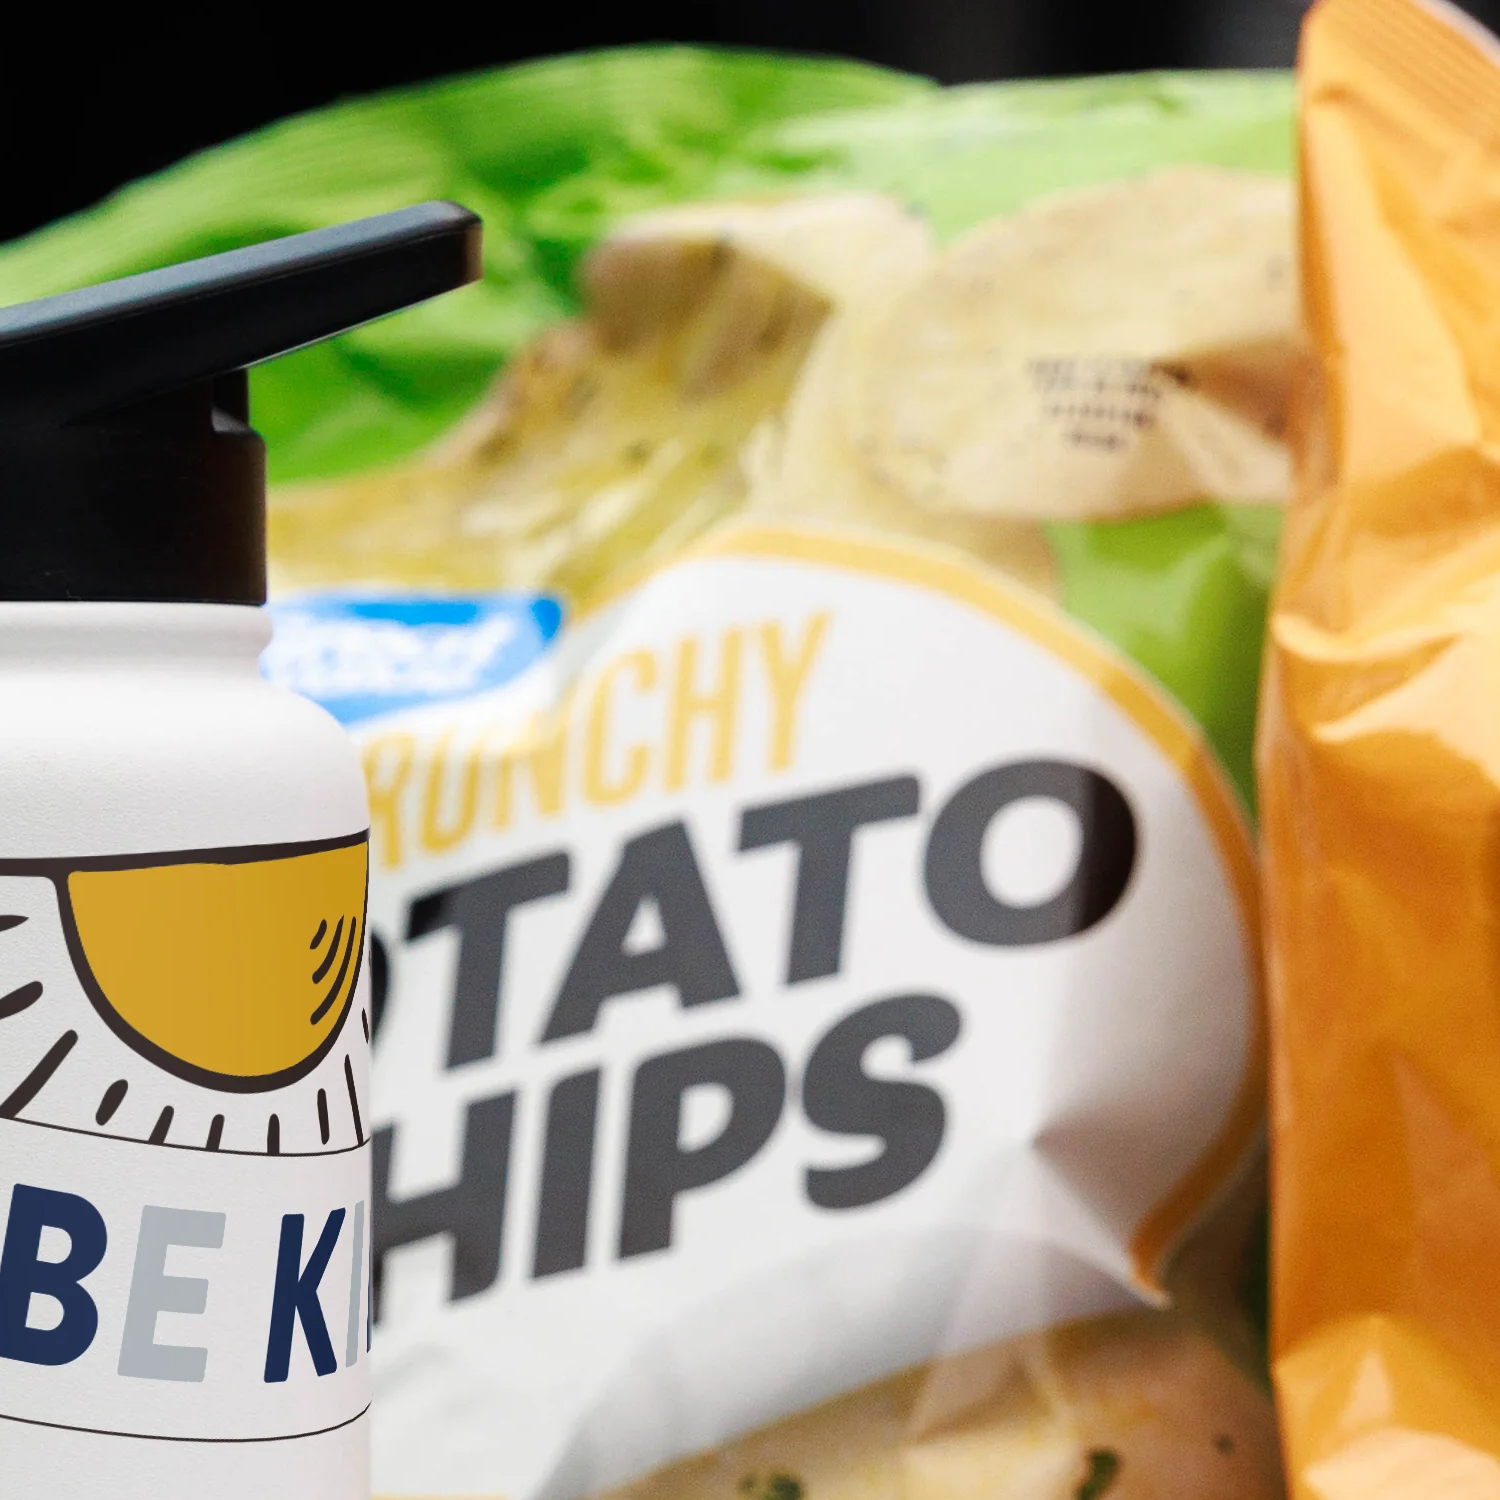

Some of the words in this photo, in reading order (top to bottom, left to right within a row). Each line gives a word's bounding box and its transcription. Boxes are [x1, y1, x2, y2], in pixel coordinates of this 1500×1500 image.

[364, 609, 833, 872] RUNCHY
[370, 755, 1139, 1075] TATO
[264, 1200, 372, 1384] KI
[370, 993, 965, 1329] HIPS
